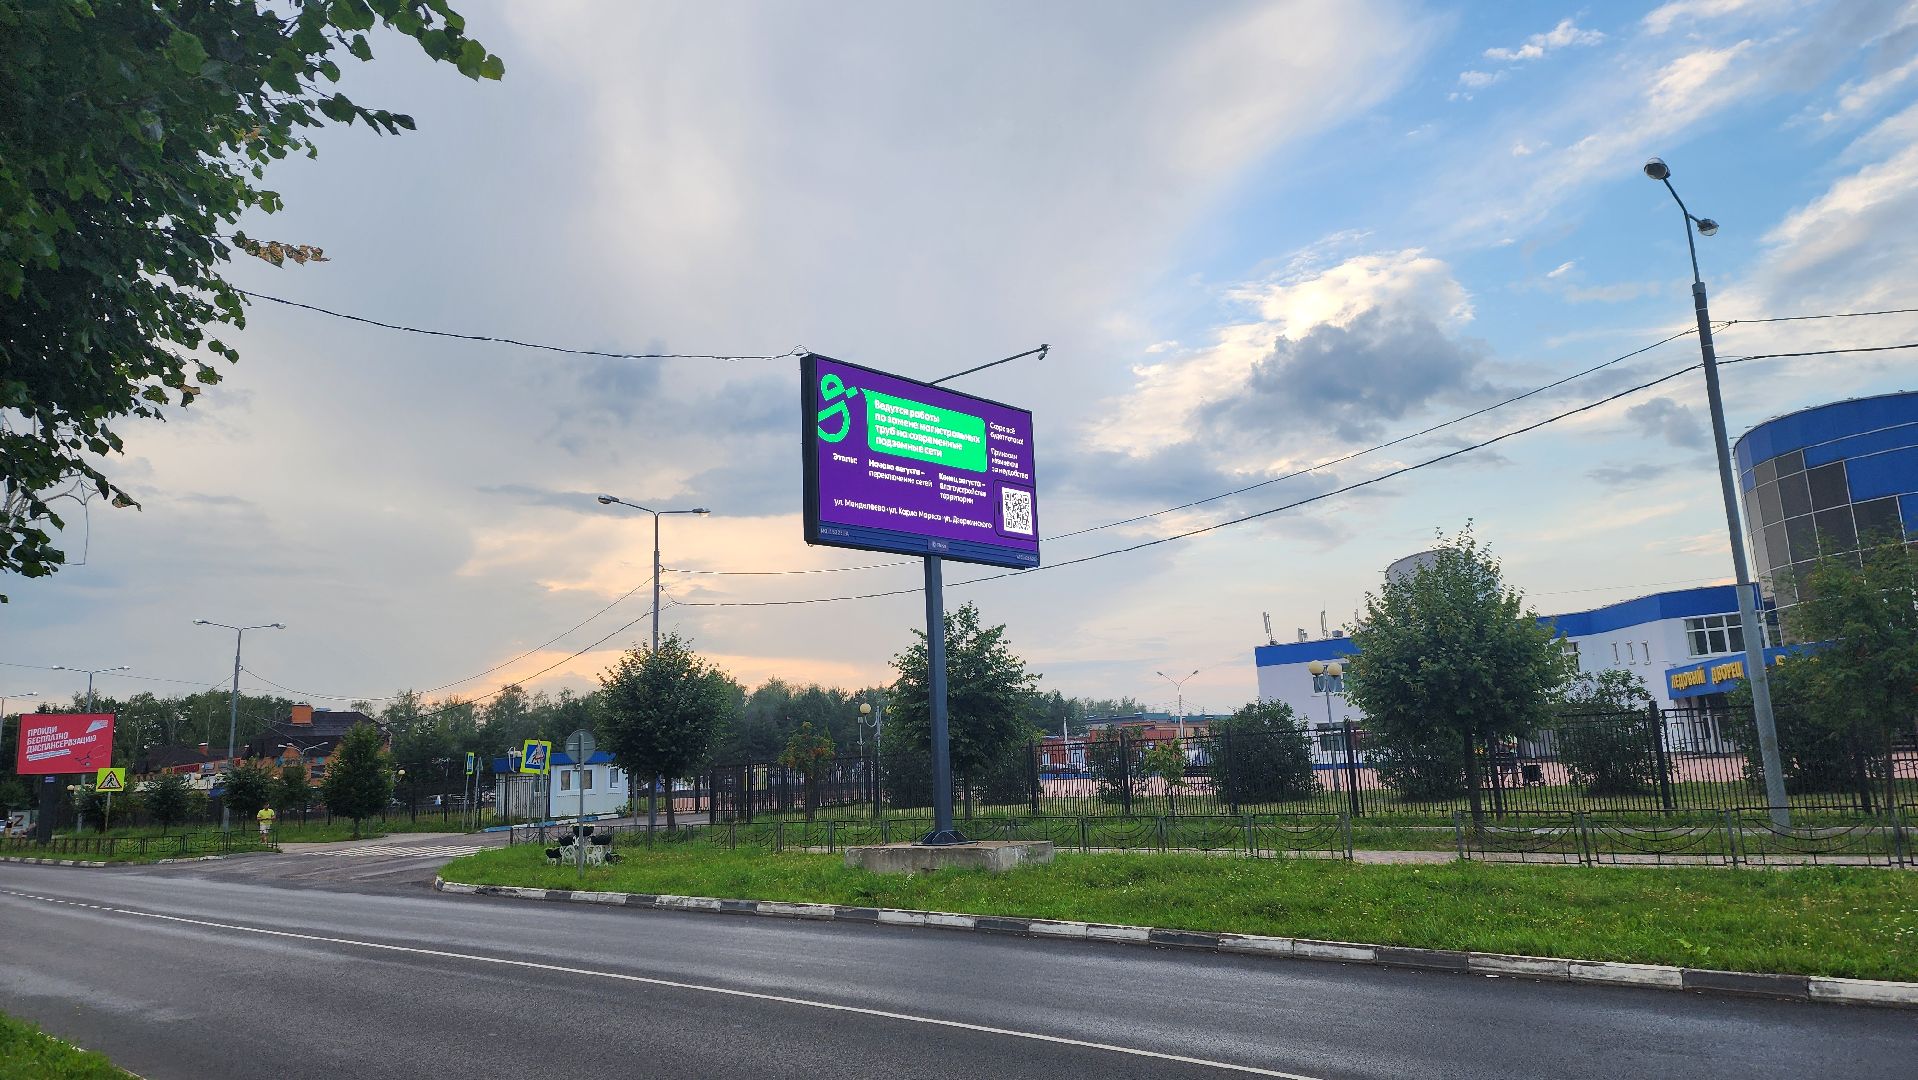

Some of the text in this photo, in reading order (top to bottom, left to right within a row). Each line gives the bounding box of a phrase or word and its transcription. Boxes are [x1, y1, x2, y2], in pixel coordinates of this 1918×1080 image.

[875, 399, 940, 423] Ведутся работы
[875, 413, 980, 443] по замене магистральных
[875, 425, 962, 450] труб на современные
[924, 446, 942, 457] сети
[895, 465, 920, 475] августа
[915, 478, 932, 488] сетей
[1671, 665, 1706, 690] ЛЕДОВЫЙ
[1711, 661, 1745, 684] ДВОРЕЦ
[26, 735, 97, 754] ДИСПАНСЕРИЗАЦИЮ
[27, 731, 69, 746] БЕСПЛАТНО
